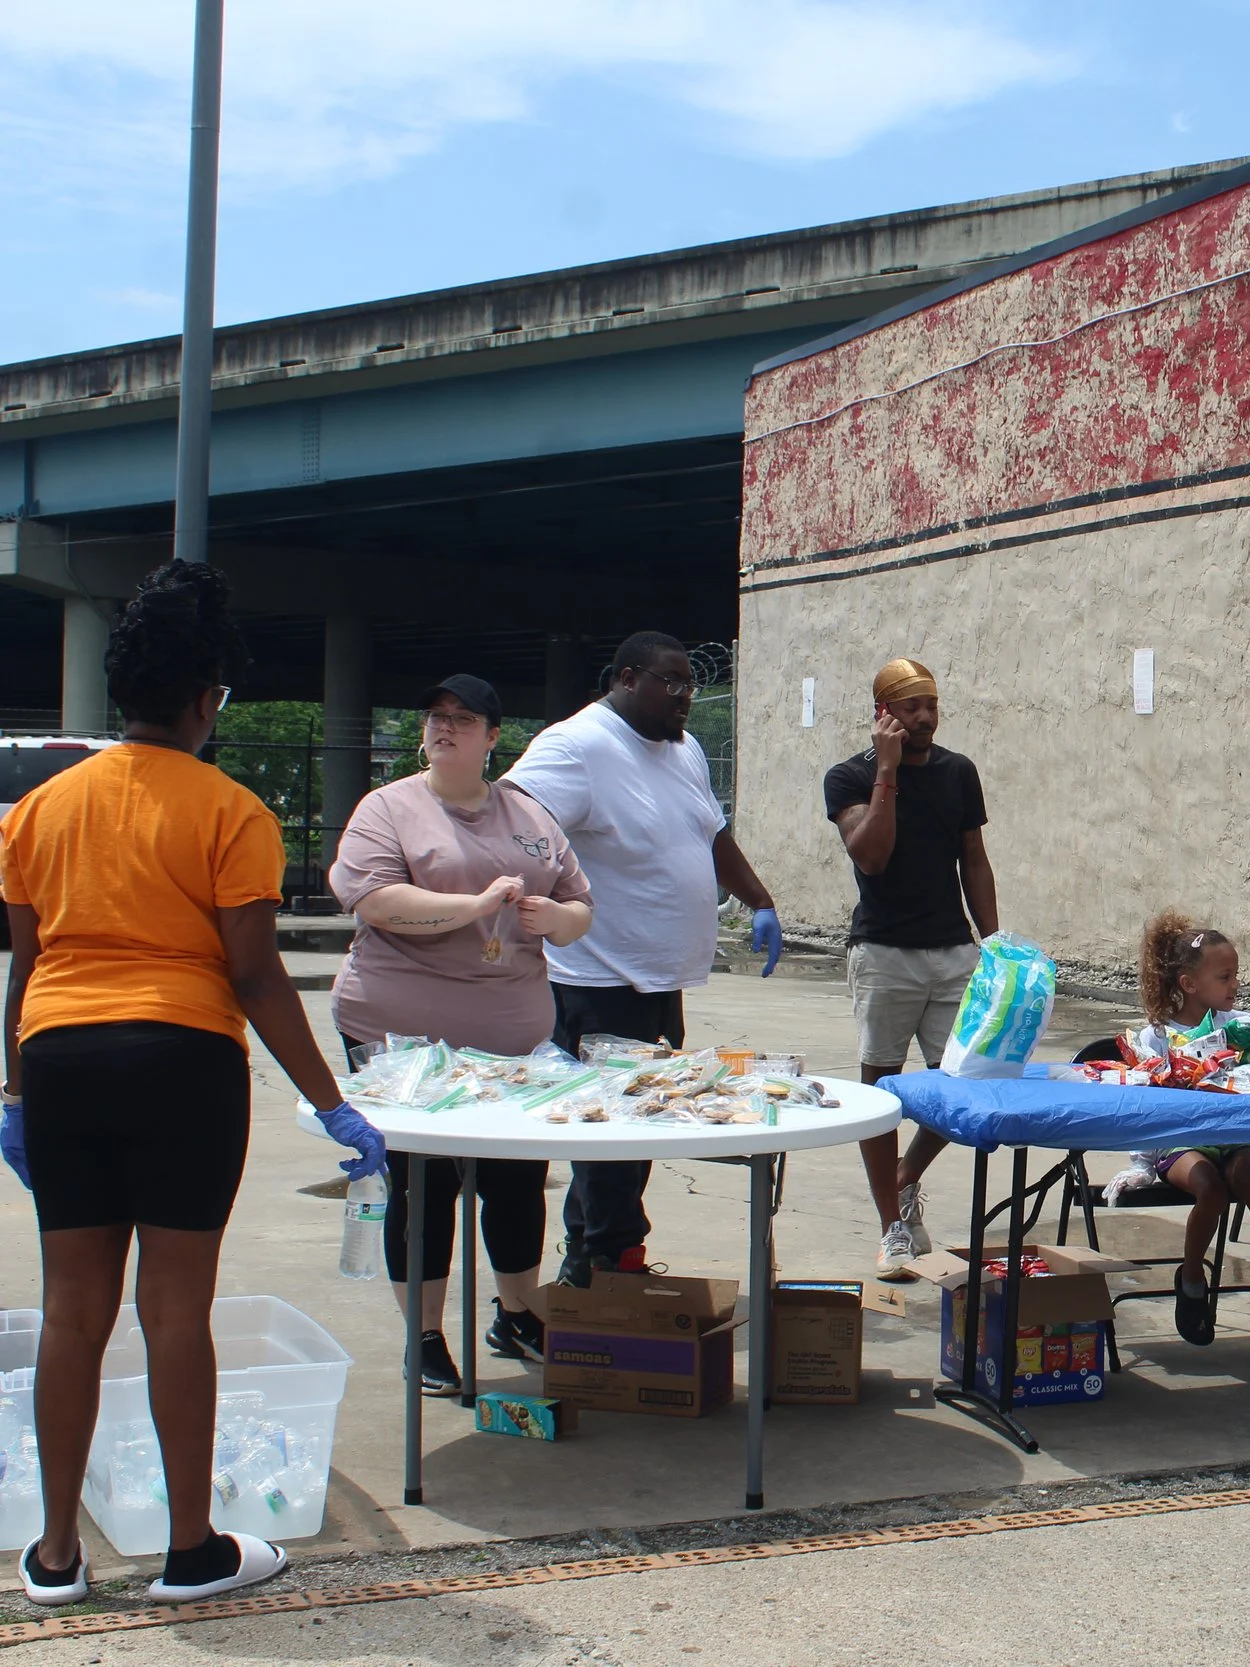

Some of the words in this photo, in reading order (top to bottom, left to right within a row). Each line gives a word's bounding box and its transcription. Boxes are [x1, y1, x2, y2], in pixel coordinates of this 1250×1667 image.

[553, 1350, 612, 1365] samoas
[986, 1363, 996, 1378] 50
[1031, 1385, 1063, 1395] CLASSIC
[1064, 1383, 1079, 1392] MIX
[1086, 1379, 1100, 1389] 50
